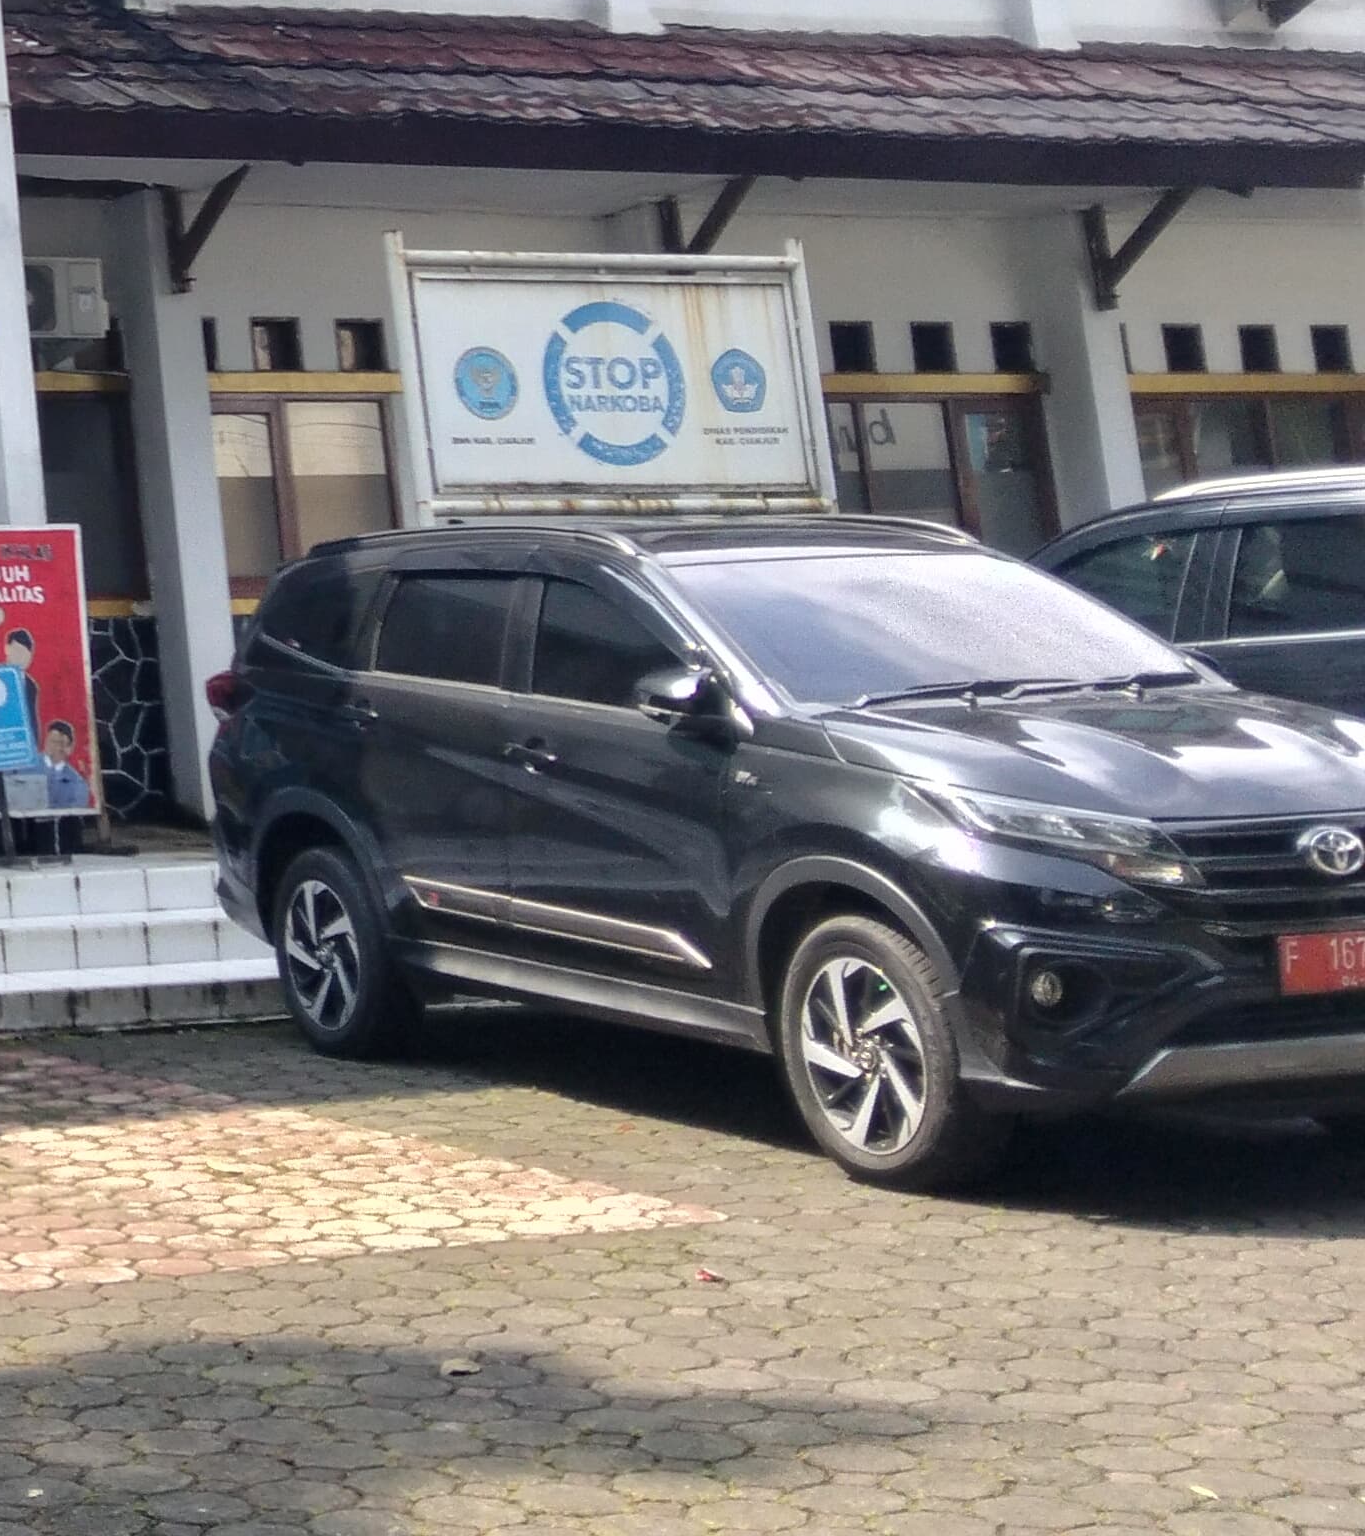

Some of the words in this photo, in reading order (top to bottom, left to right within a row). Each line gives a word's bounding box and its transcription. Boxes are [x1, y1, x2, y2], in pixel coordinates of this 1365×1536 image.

[565, 356, 663, 390] STOP
[568, 395, 666, 413] NARKOBA
[1284, 941, 1299, 974] F
